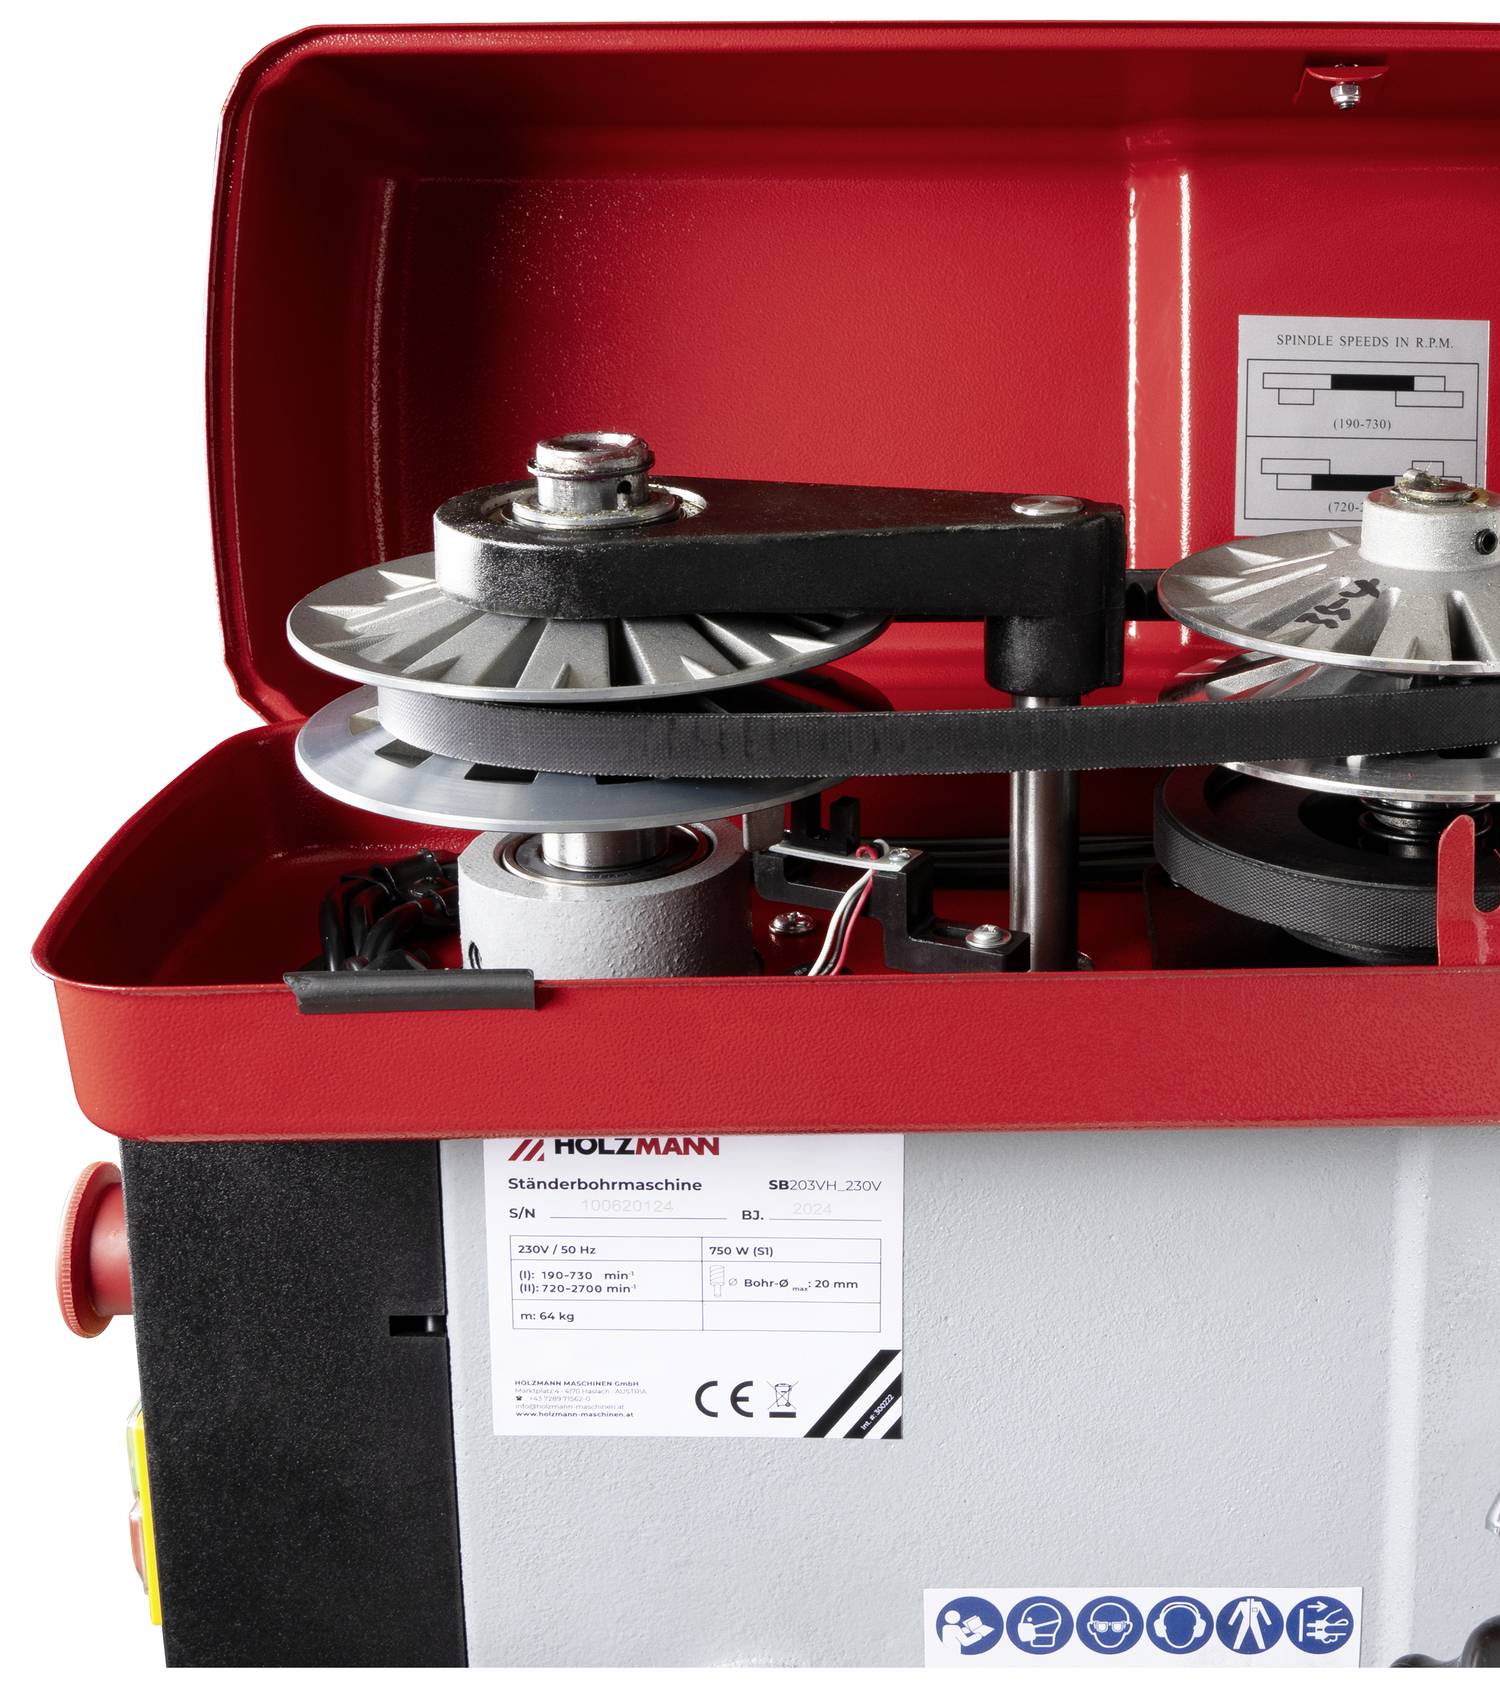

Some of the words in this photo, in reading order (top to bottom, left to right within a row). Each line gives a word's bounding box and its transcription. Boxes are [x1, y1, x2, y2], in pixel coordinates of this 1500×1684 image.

[1277, 334, 1333, 346] SPINDLE
[1339, 335, 1389, 347] SPEEDS
[1395, 337, 1409, 347] IN
[1416, 337, 1454, 349] R.P.M.
[1333, 418, 1392, 431] (190-730)
[554, 1137, 720, 1155] HOLZMANN
[508, 1178, 702, 1191] Ständerbohrmaschine
[768, 1180, 882, 1192] SB203VH_230V
[509, 1207, 536, 1219] S/N
[742, 1210, 764, 1221] BJ.
[793, 1202, 832, 1216] 2024
[518, 1245, 549, 1254] 230V
[552, 1244, 558, 1255] /
[561, 1246, 576, 1254] 50
[580, 1246, 596, 1254] Hz
[709, 1246, 732, 1255] 750
[736, 1247, 749, 1255] W
[753, 1247, 774, 1258] (S1)
[541, 1271, 593, 1280] 190-730
[542, 1284, 602, 1293] 720-2700
[814, 1280, 830, 1289] 20
[833, 1280, 859, 1289] mm
[520, 1312, 536, 1320] m:
[539, 1311, 555, 1320] 64
[559, 1311, 575, 1323] kg
